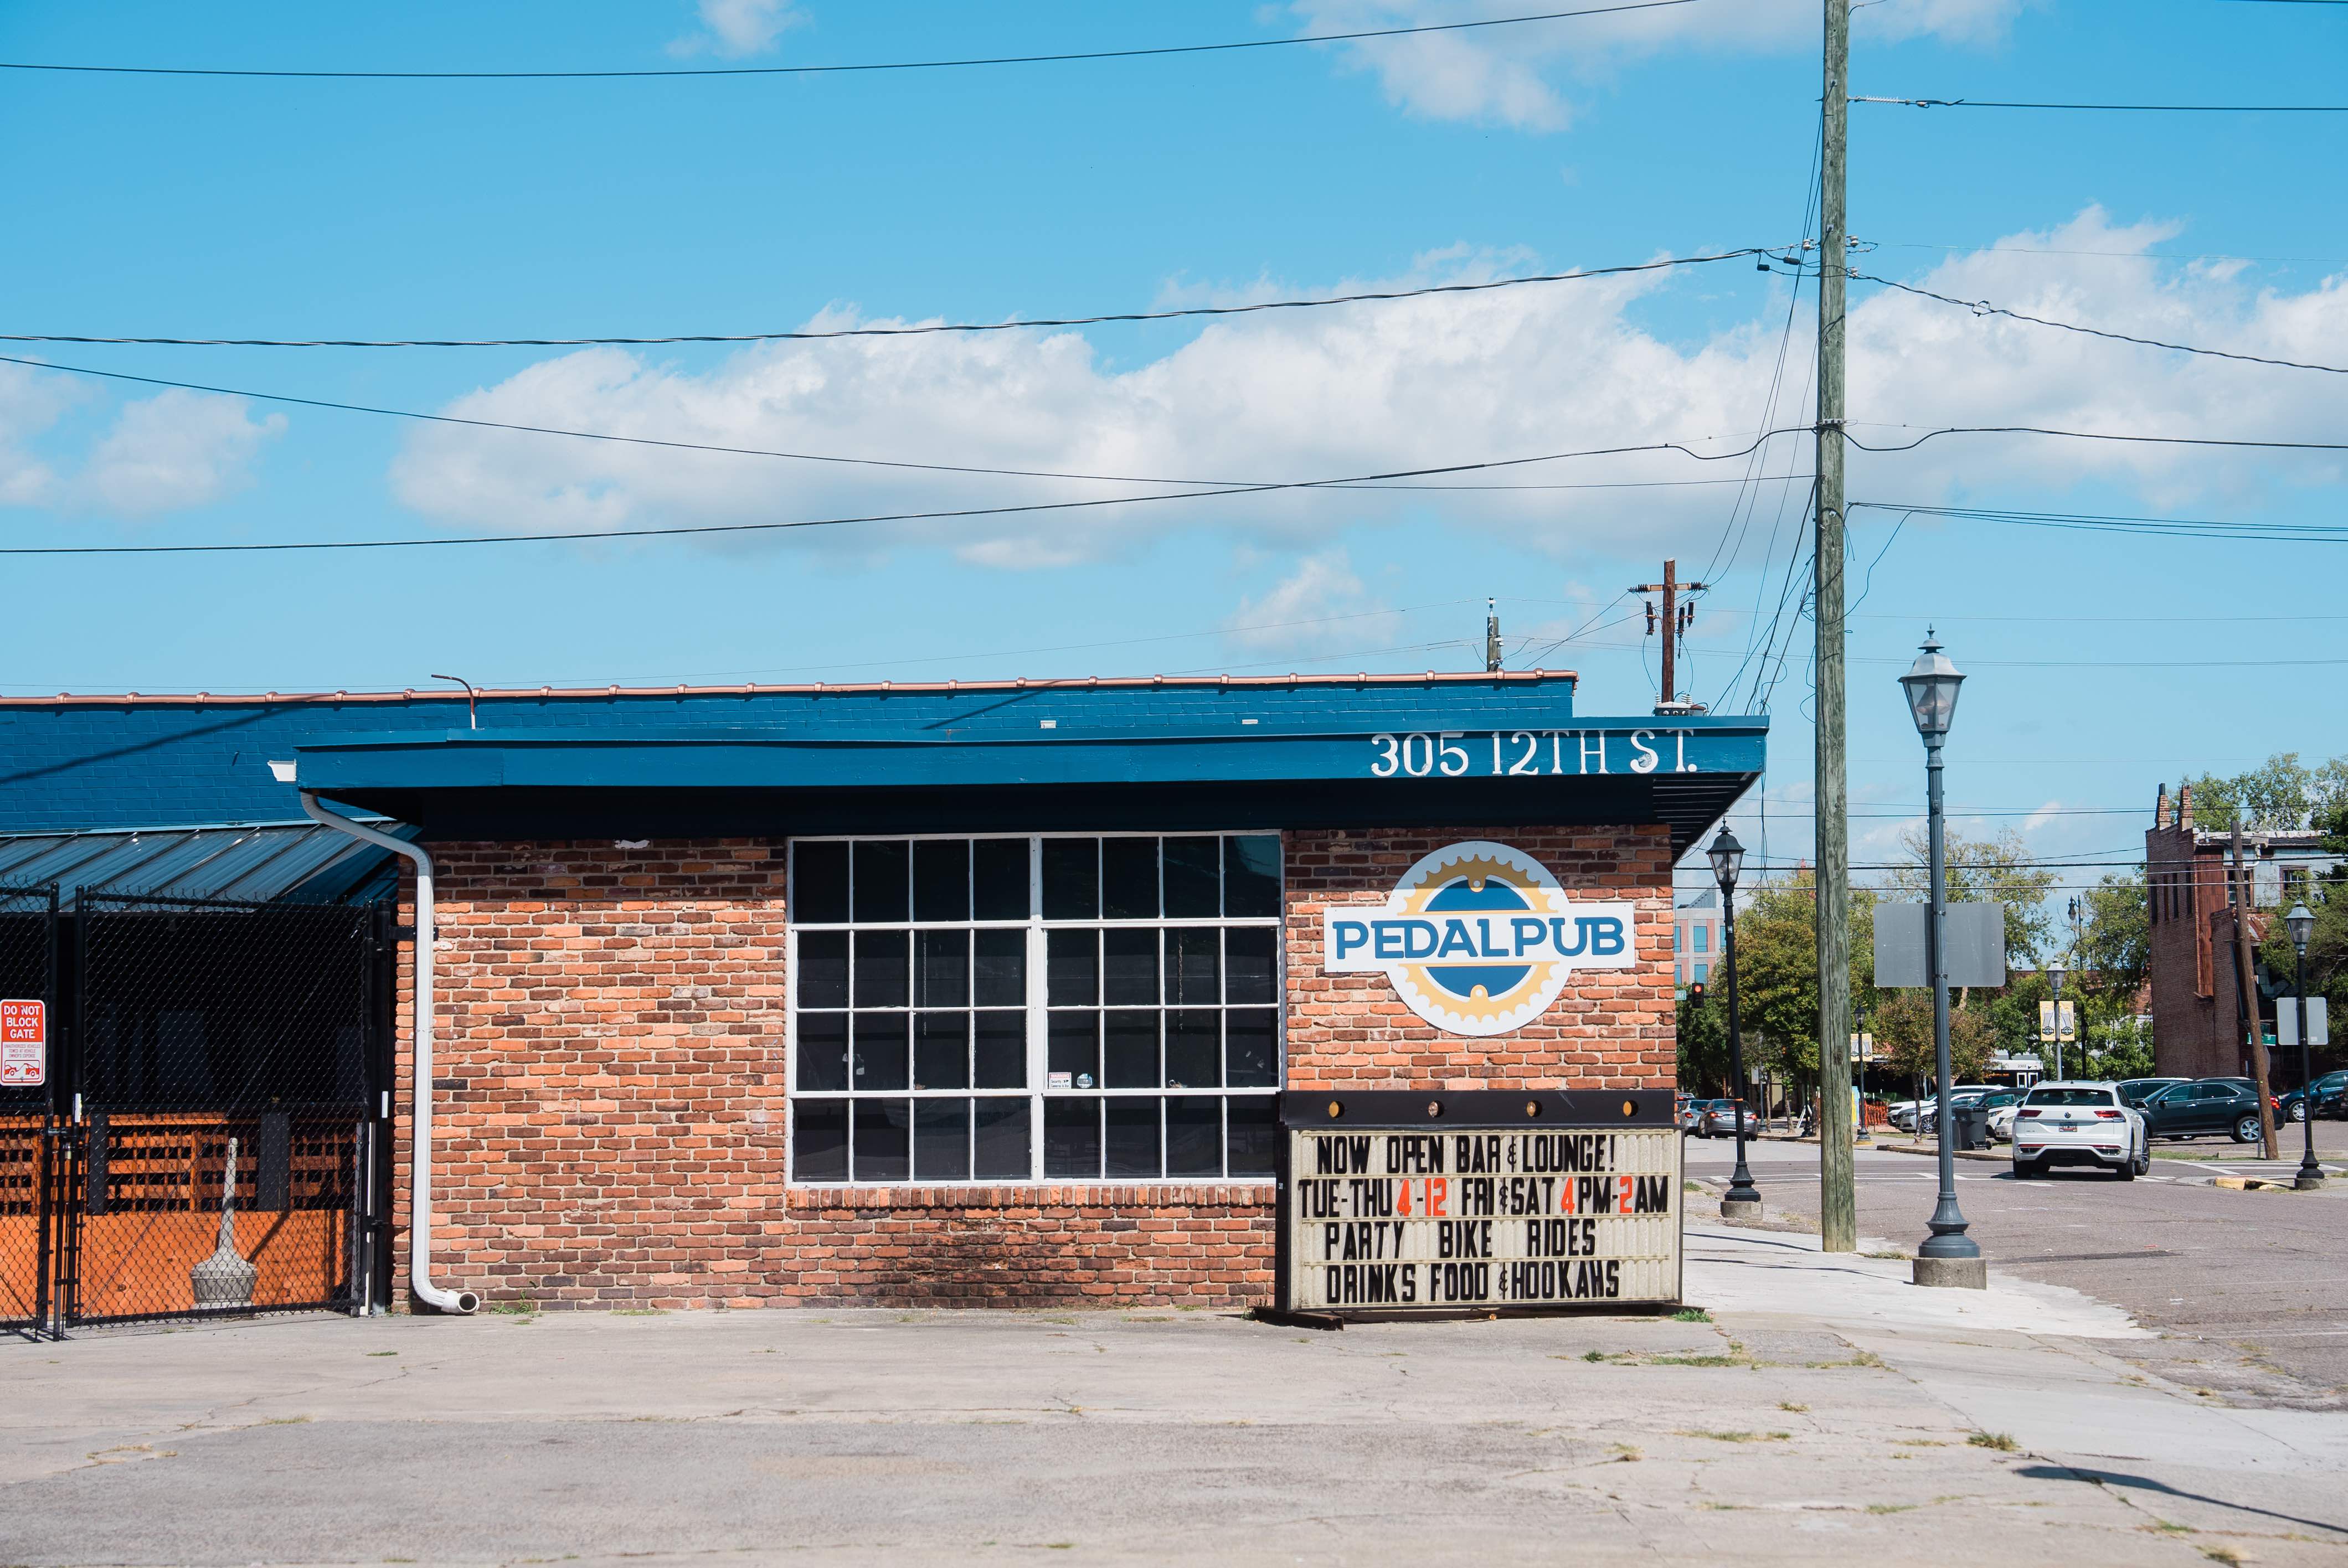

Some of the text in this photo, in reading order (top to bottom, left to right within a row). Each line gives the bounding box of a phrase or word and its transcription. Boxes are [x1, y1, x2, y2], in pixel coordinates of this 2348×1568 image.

[1371, 729, 1698, 776] 305 12TH ST.
[1332, 916, 1625, 960] PEDALPUB
[3, 1005, 40, 1015] DO NOT
[7, 1017, 38, 1027] BLOCK
[10, 1029, 35, 1039] GATE
[1317, 1134, 1615, 1174] NOW OPEN BAR & LOUNGE!
[1461, 1178, 1494, 1216] FRI
[1511, 1177, 1555, 1215] SAT
[1326, 1219, 1595, 1260] PARTY BIKE RIDES
[1327, 1260, 1619, 1304] DRINKS FOOD & HOOKAHS
